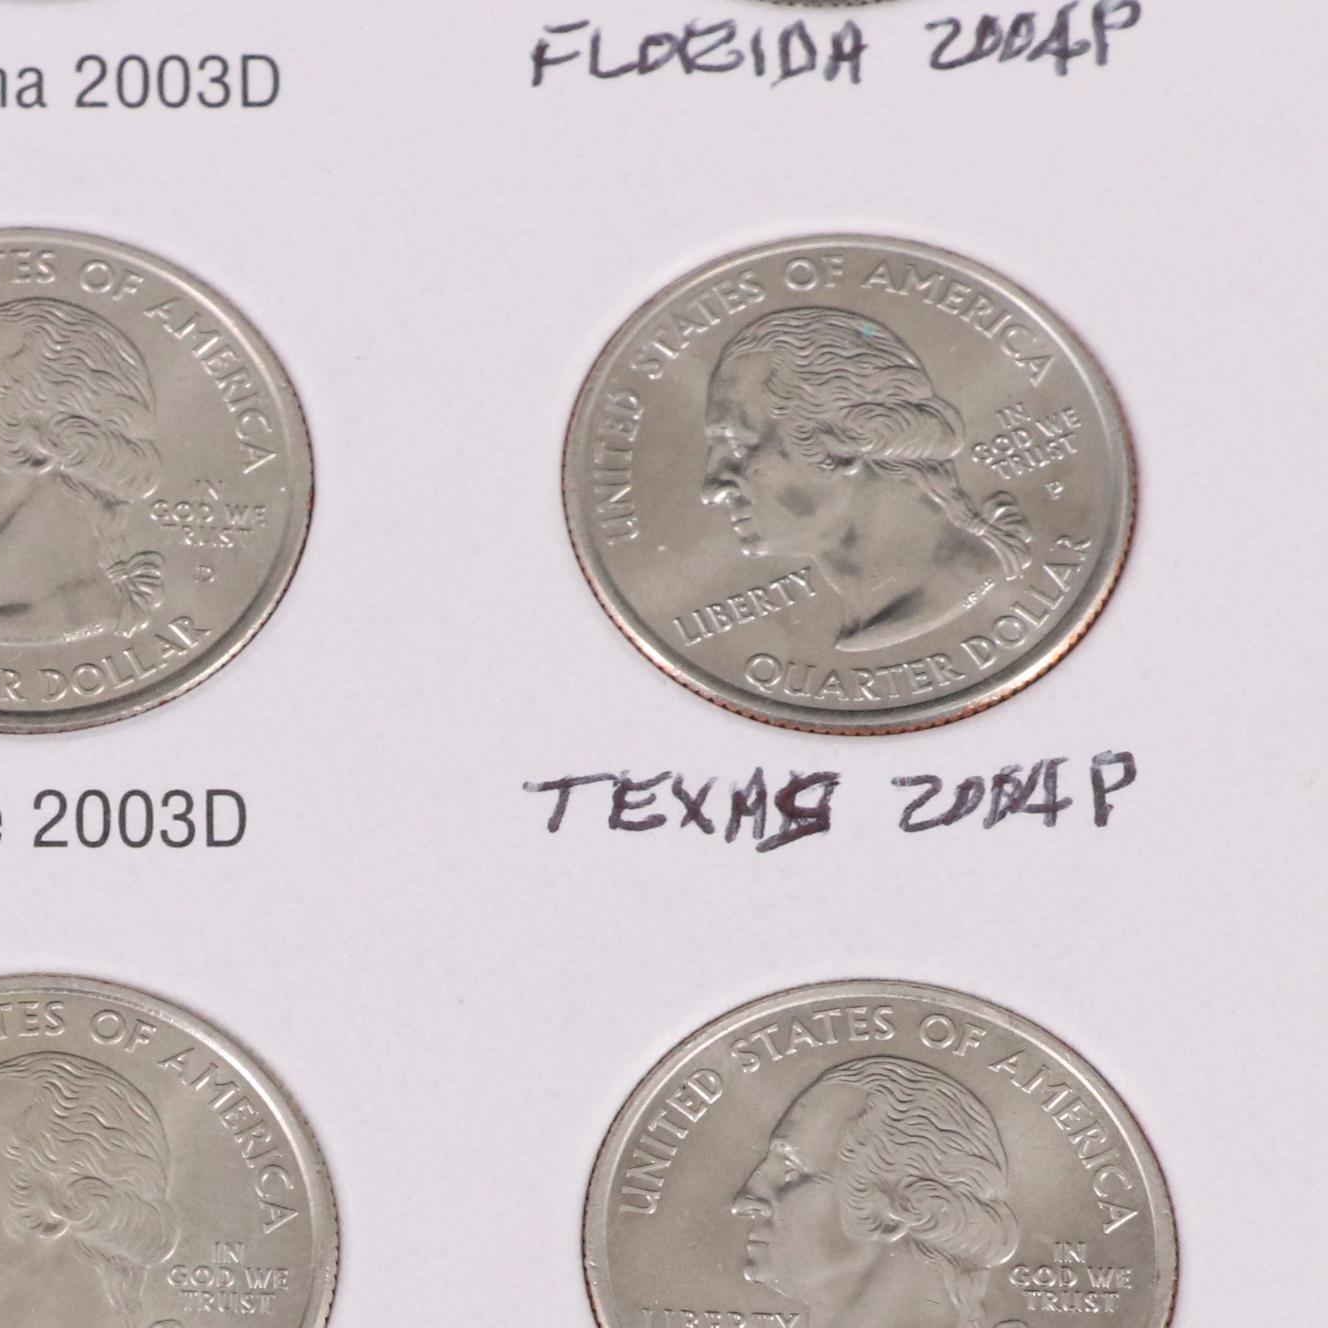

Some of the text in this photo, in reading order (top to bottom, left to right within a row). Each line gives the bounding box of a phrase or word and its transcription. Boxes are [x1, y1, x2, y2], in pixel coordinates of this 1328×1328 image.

[76, 54, 280, 109] 2003D
[81, 259, 144, 299] OF
[144, 298, 276, 474] AMERICA
[594, 256, 1056, 545] UNITED STATES OF AMERICA
[997, 401, 1030, 428] IN
[972, 406, 1082, 464] GOD WE
[990, 434, 1078, 481] TRUST
[149, 499, 265, 527] GOD WE
[197, 479, 223, 500] IN
[164, 524, 257, 549] TRUST
[673, 567, 818, 646] LIBERTY
[744, 536, 1092, 702] QUARTER DOLLAR
[39, 614, 211, 701] DOLLAR
[33, 789, 248, 849] 2003D
[90, 1008, 157, 1052] OF
[158, 1047, 299, 1235] AMERICA
[620, 1005, 1138, 1235] UNITED STATES OF AMERICA
[211, 1242, 244, 1263] IN
[1053, 1242, 1085, 1263] IN
[170, 1264, 288, 1291] GOD WE
[1009, 1264, 1131, 1290] GOD WE
[178, 1291, 275, 1314] TRUST
[1024, 1292, 1120, 1313] TRUST
